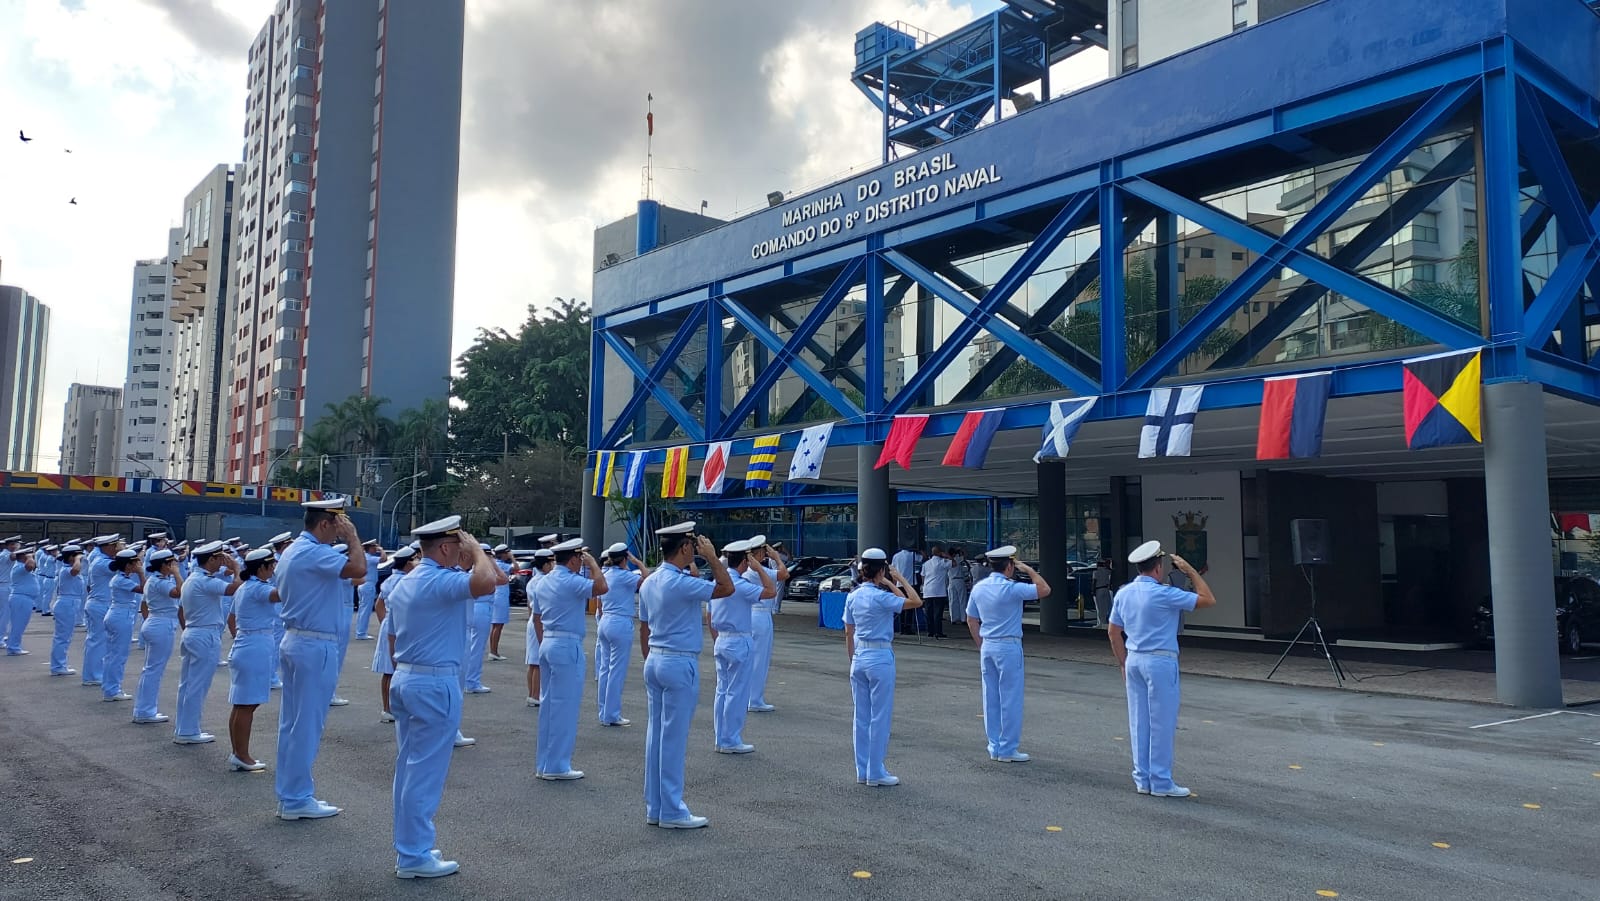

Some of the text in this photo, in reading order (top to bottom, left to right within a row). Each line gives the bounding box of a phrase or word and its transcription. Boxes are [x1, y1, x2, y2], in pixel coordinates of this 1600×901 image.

[751, 226, 816, 259] COMANDO
[820, 218, 841, 237] DO
[865, 184, 939, 224] DISTRITO
[944, 164, 1002, 197] NAVAL
[782, 152, 957, 227] MARINHA DO BRASIL
